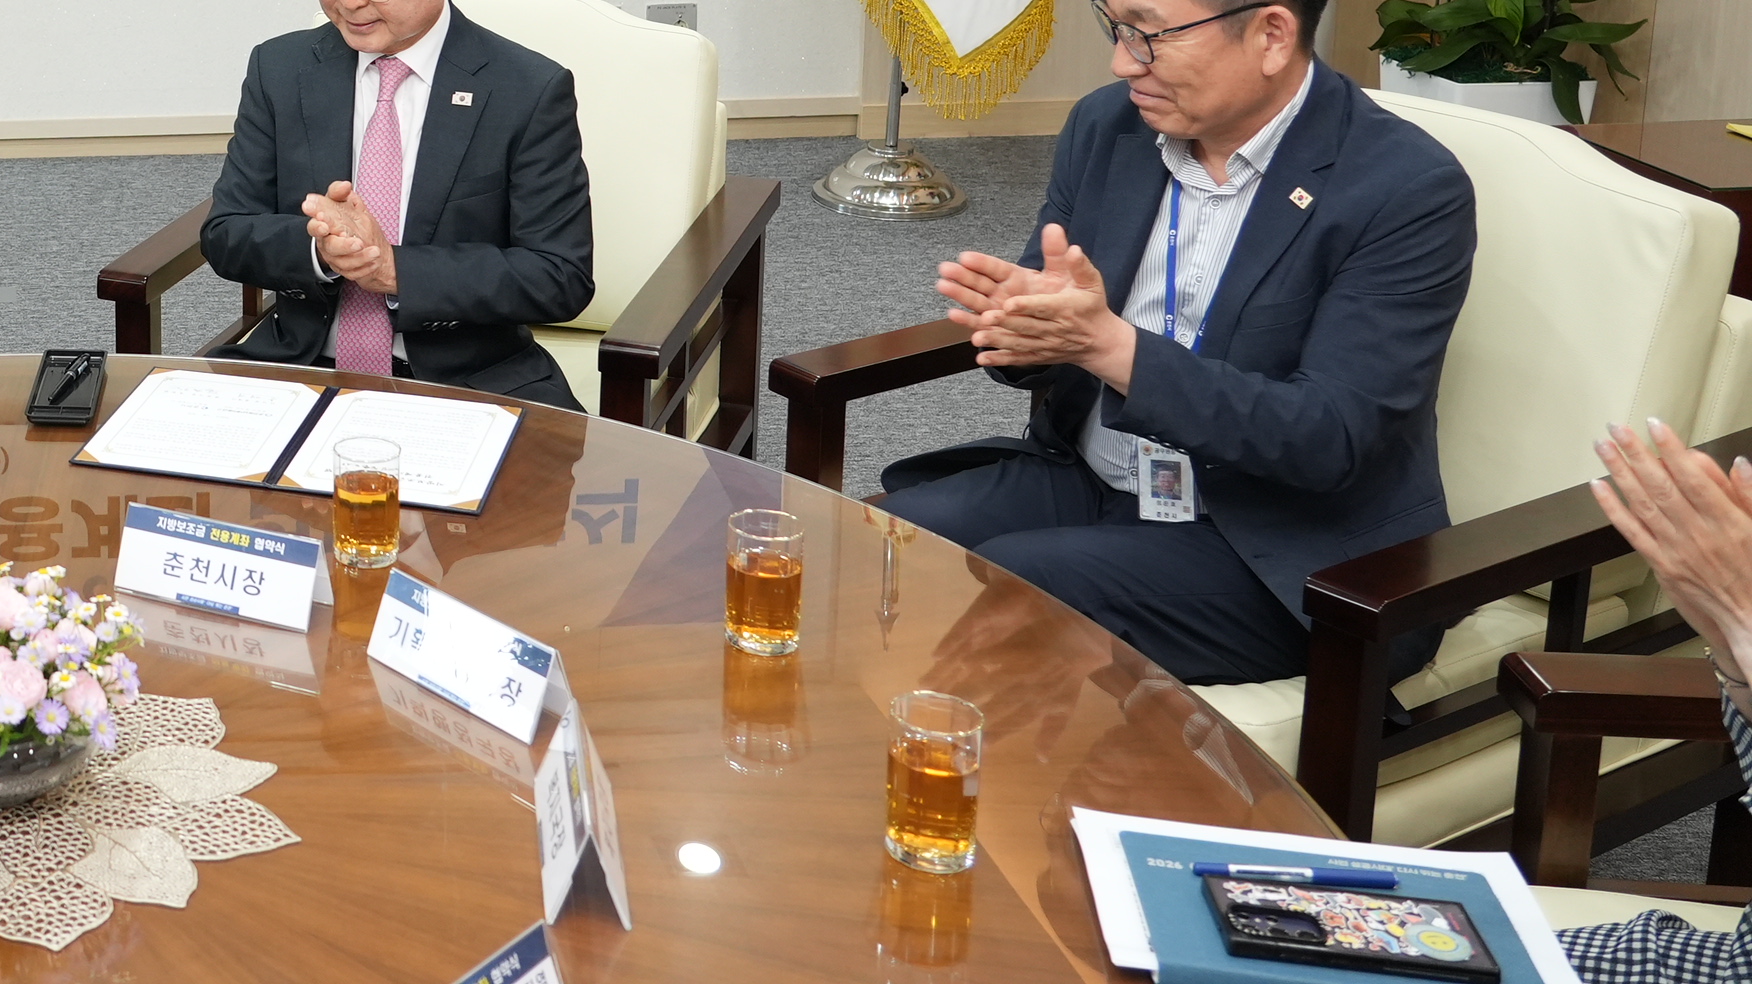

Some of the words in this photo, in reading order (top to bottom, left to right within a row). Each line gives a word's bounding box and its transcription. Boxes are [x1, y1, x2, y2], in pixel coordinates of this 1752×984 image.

[156, 516, 206, 538] 지방보조금
[209, 527, 250, 547] 전용계좌
[254, 537, 286, 555] 협약식
[162, 551, 266, 596] 춘천시장
[1146, 857, 1184, 870] 2026
